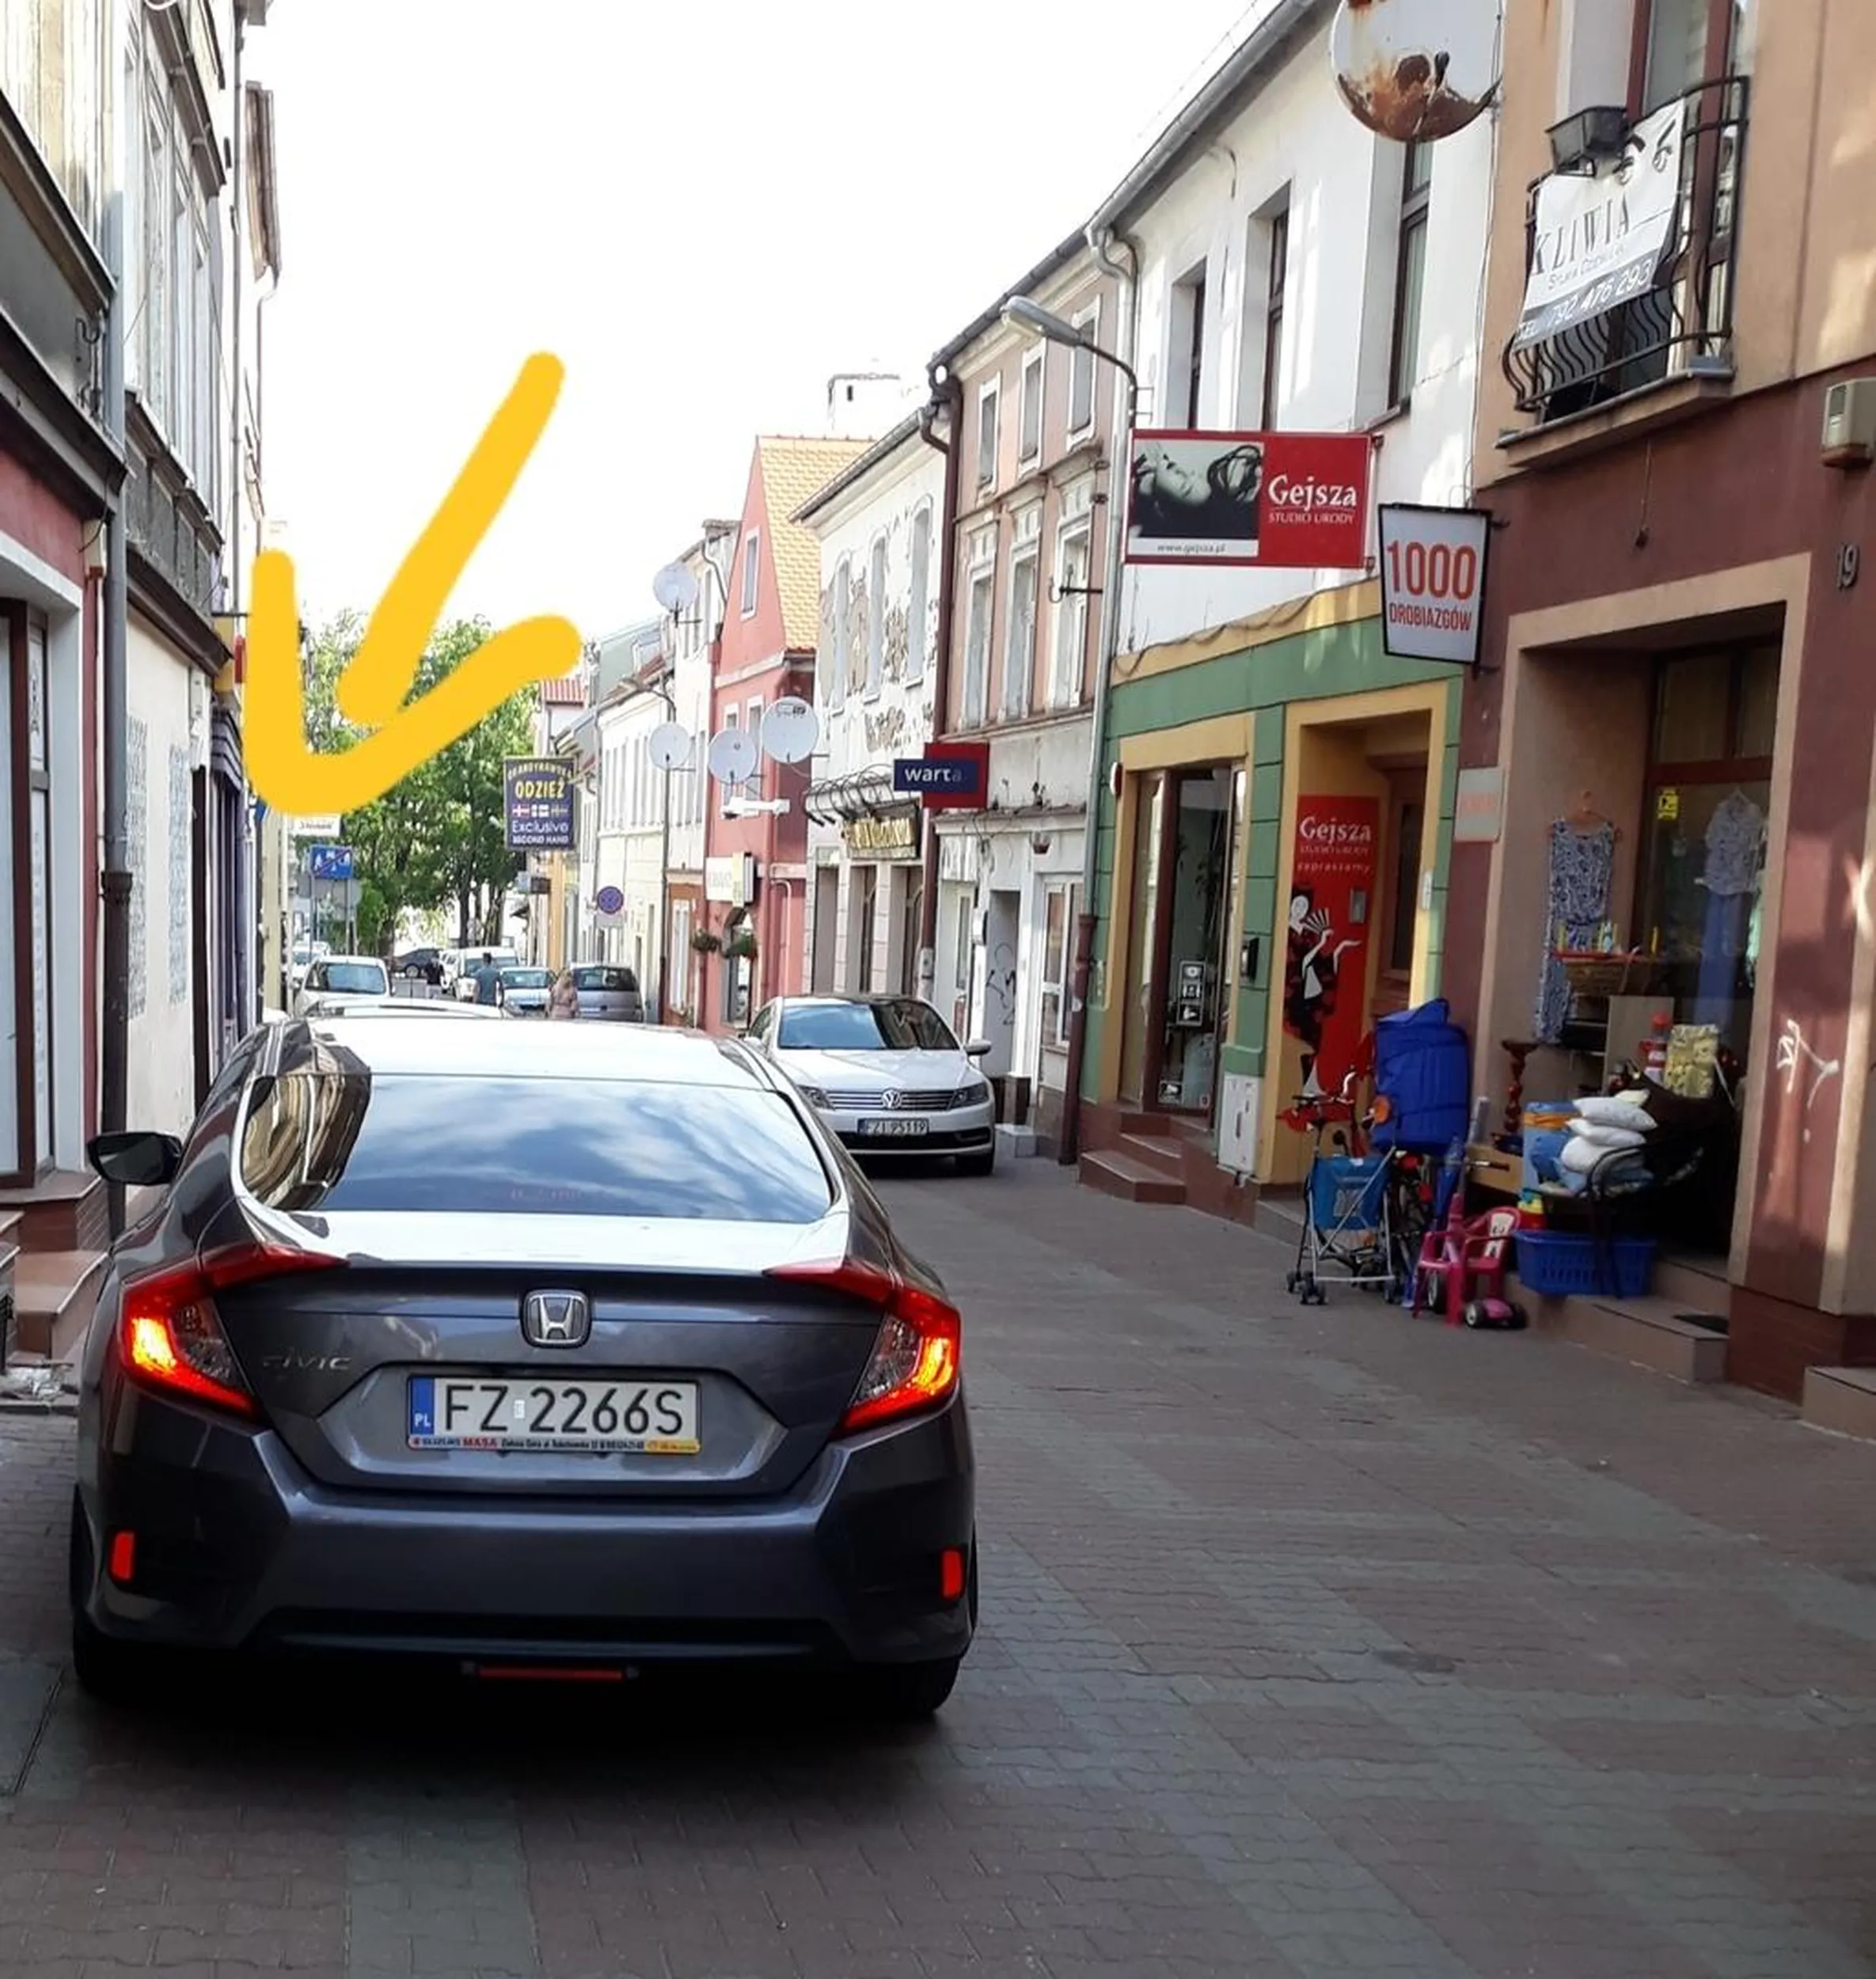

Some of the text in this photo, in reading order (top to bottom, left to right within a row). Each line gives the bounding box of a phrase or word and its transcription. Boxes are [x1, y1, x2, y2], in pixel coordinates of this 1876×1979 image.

[1616, 258, 1654, 296] 293
[1268, 473, 1358, 511] Gejsza
[1268, 512, 1311, 525] STUDIO
[1387, 539, 1477, 602] 1000
[1836, 543, 1859, 590] 19
[1388, 602, 1472, 632] DROBIAZGÓW
[515, 775, 565, 800] ODZIEŻ
[904, 765, 963, 783] warta
[1299, 815, 1372, 845] Gejsza
[263, 1354, 352, 1371] CIVIC
[414, 1414, 431, 1428] PL
[445, 1385, 683, 1435] FZ 2266S
